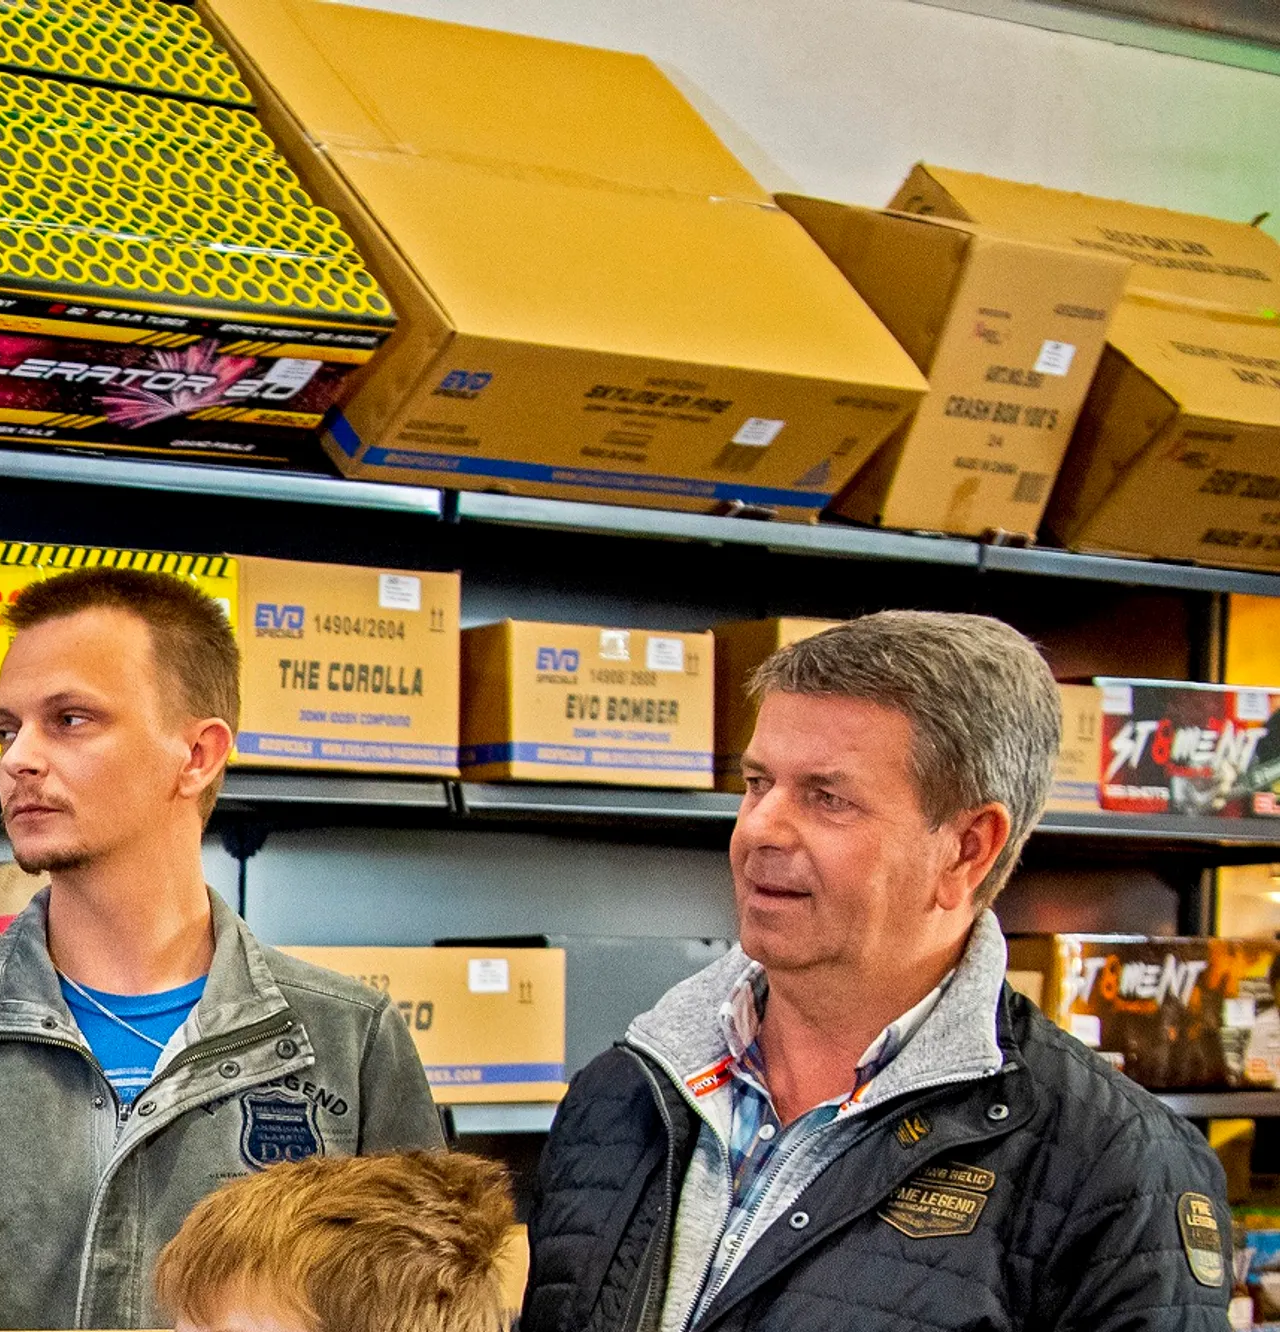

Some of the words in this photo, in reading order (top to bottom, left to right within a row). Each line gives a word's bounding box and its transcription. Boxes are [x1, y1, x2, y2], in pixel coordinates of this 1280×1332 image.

[255, 603, 305, 631] EVO
[255, 627, 305, 640] SPECIALS
[535, 646, 581, 674] EVO
[278, 658, 320, 692] THE
[326, 660, 424, 698] COROLLA
[565, 693, 599, 721] EVO
[606, 695, 680, 725] BOMBER
